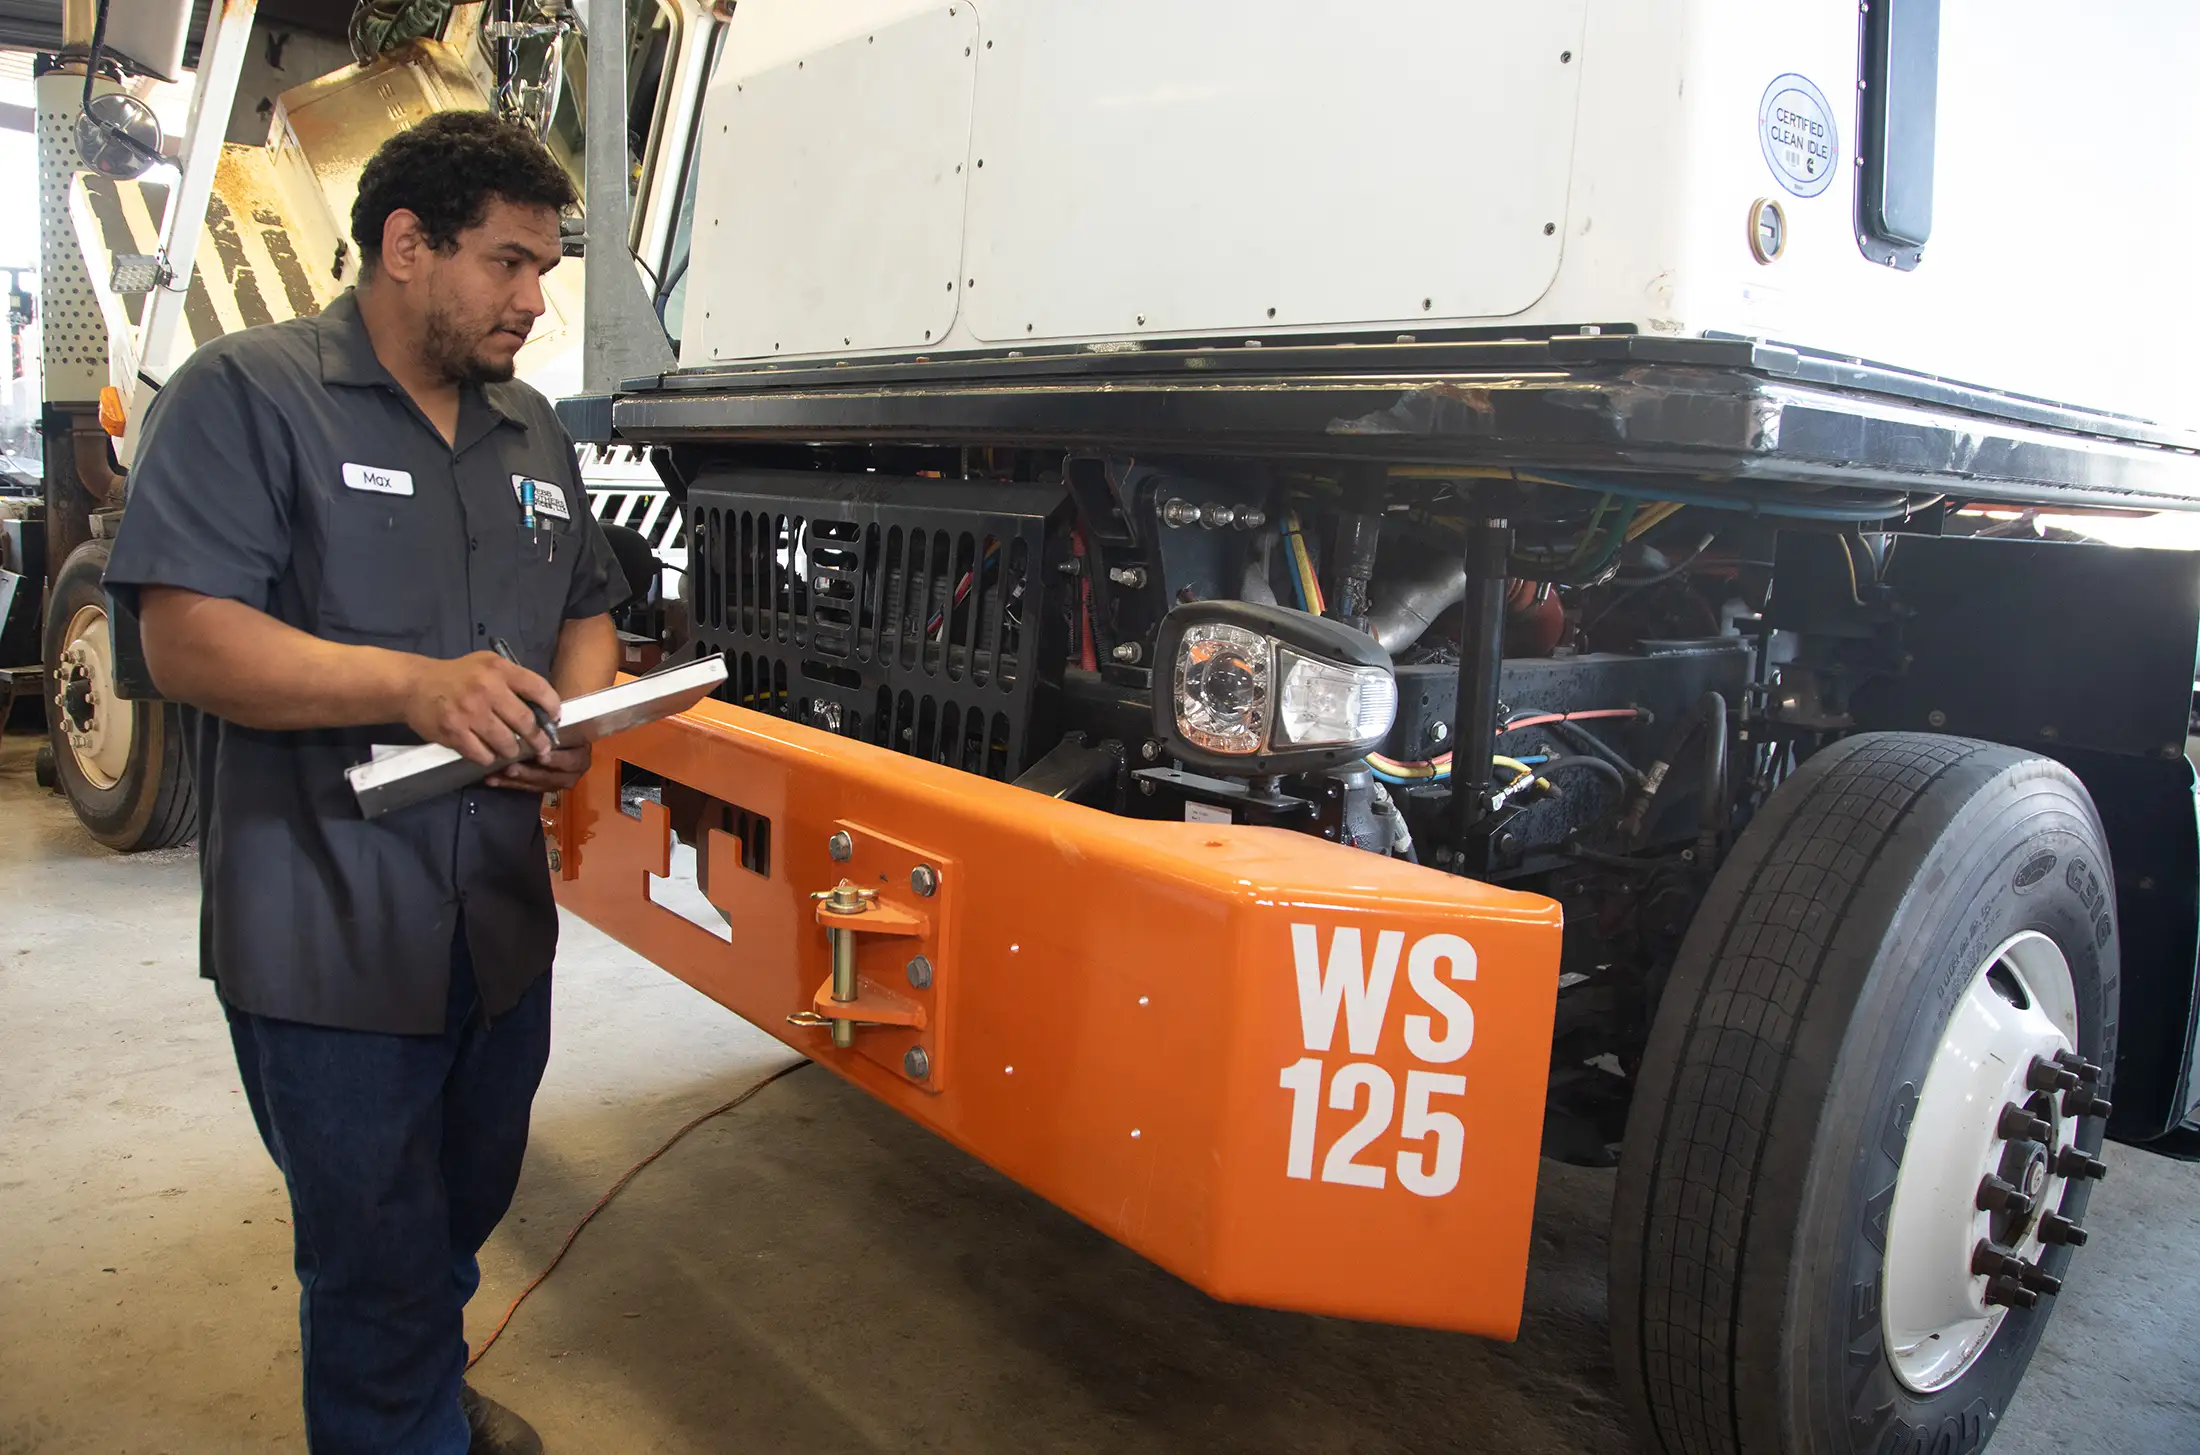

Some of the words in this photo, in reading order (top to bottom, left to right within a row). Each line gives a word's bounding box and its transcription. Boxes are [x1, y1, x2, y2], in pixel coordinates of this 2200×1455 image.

[1771, 125, 1804, 150] CLEAN
[1807, 139, 1828, 160] IDLE
[1776, 107, 1824, 138] CERTIFIED
[363, 471, 392, 489] Max
[2066, 855, 2112, 950] G316
[1290, 922, 1478, 1064] WS
[1279, 1056, 1467, 1198] 125
